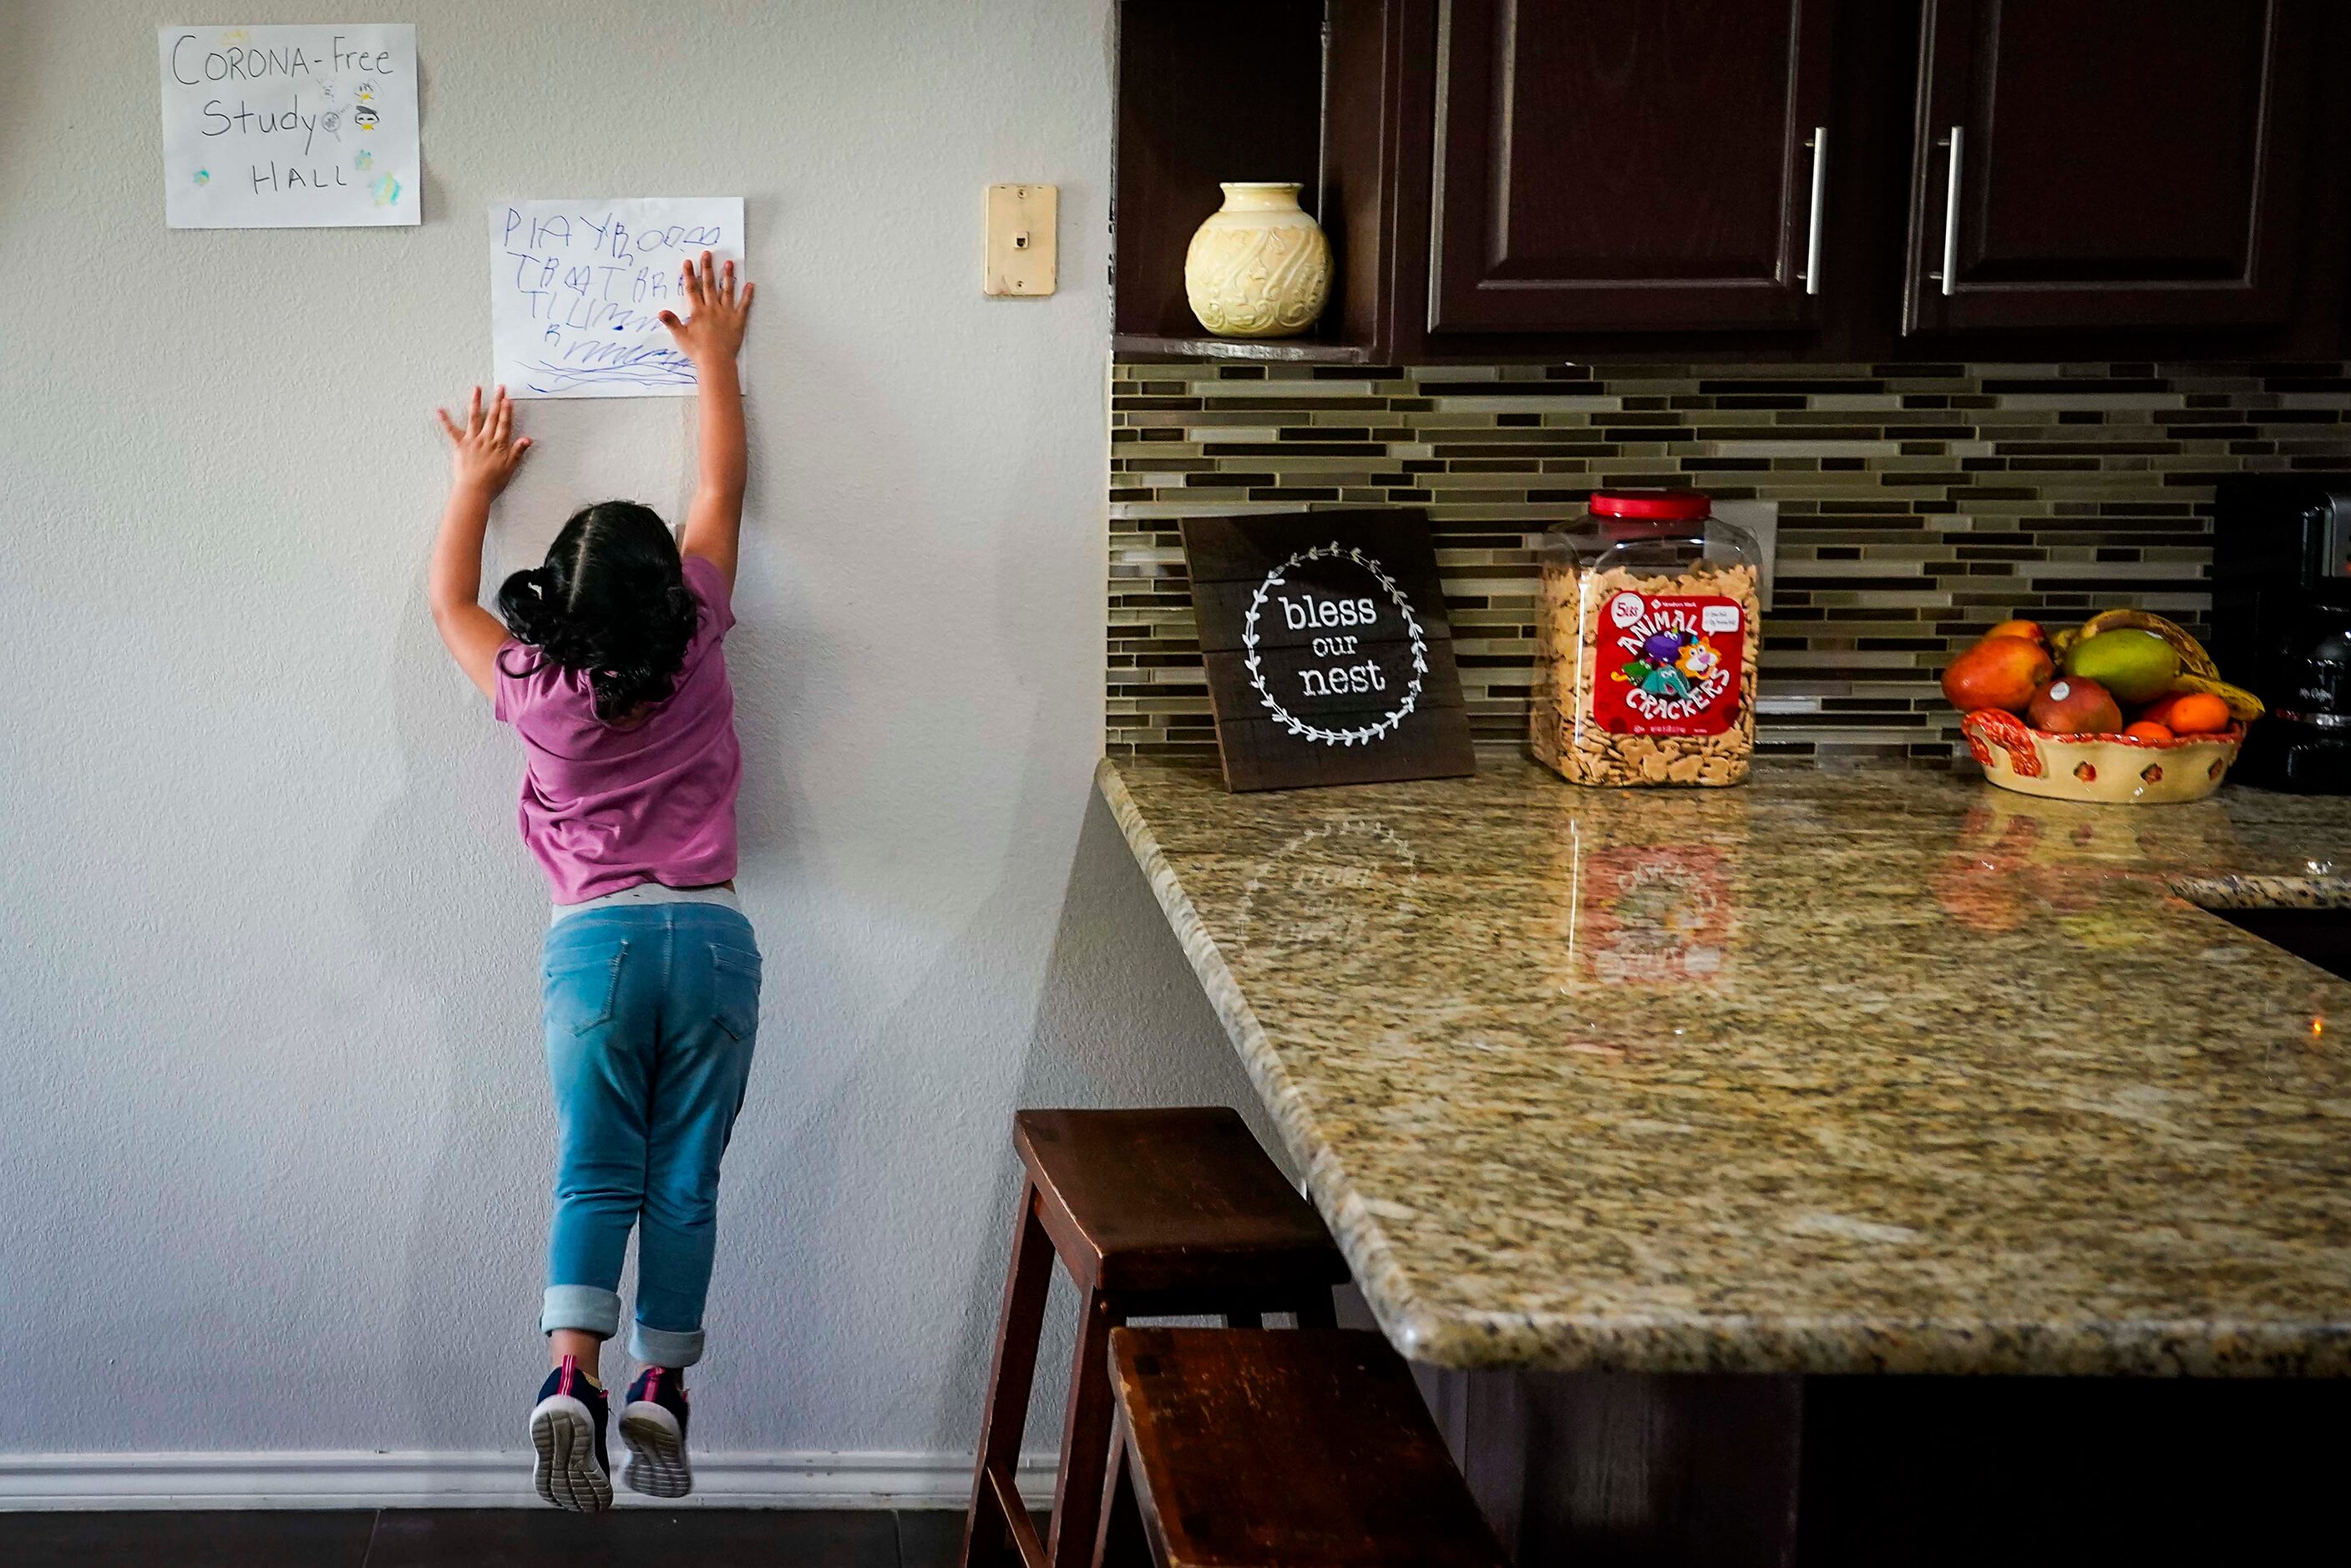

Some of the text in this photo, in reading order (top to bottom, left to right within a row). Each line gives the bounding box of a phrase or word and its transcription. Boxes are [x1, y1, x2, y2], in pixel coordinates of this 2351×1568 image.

[173, 35, 393, 84] CORONA-Free
[201, 94, 317, 155] Study
[252, 160, 347, 194] HALL
[1278, 594, 1377, 630] bless
[1617, 609, 1699, 655] ANIMAL
[1312, 635, 1358, 657] our
[1298, 660, 1386, 696] nest
[1625, 667, 1730, 721] CRACKERS
